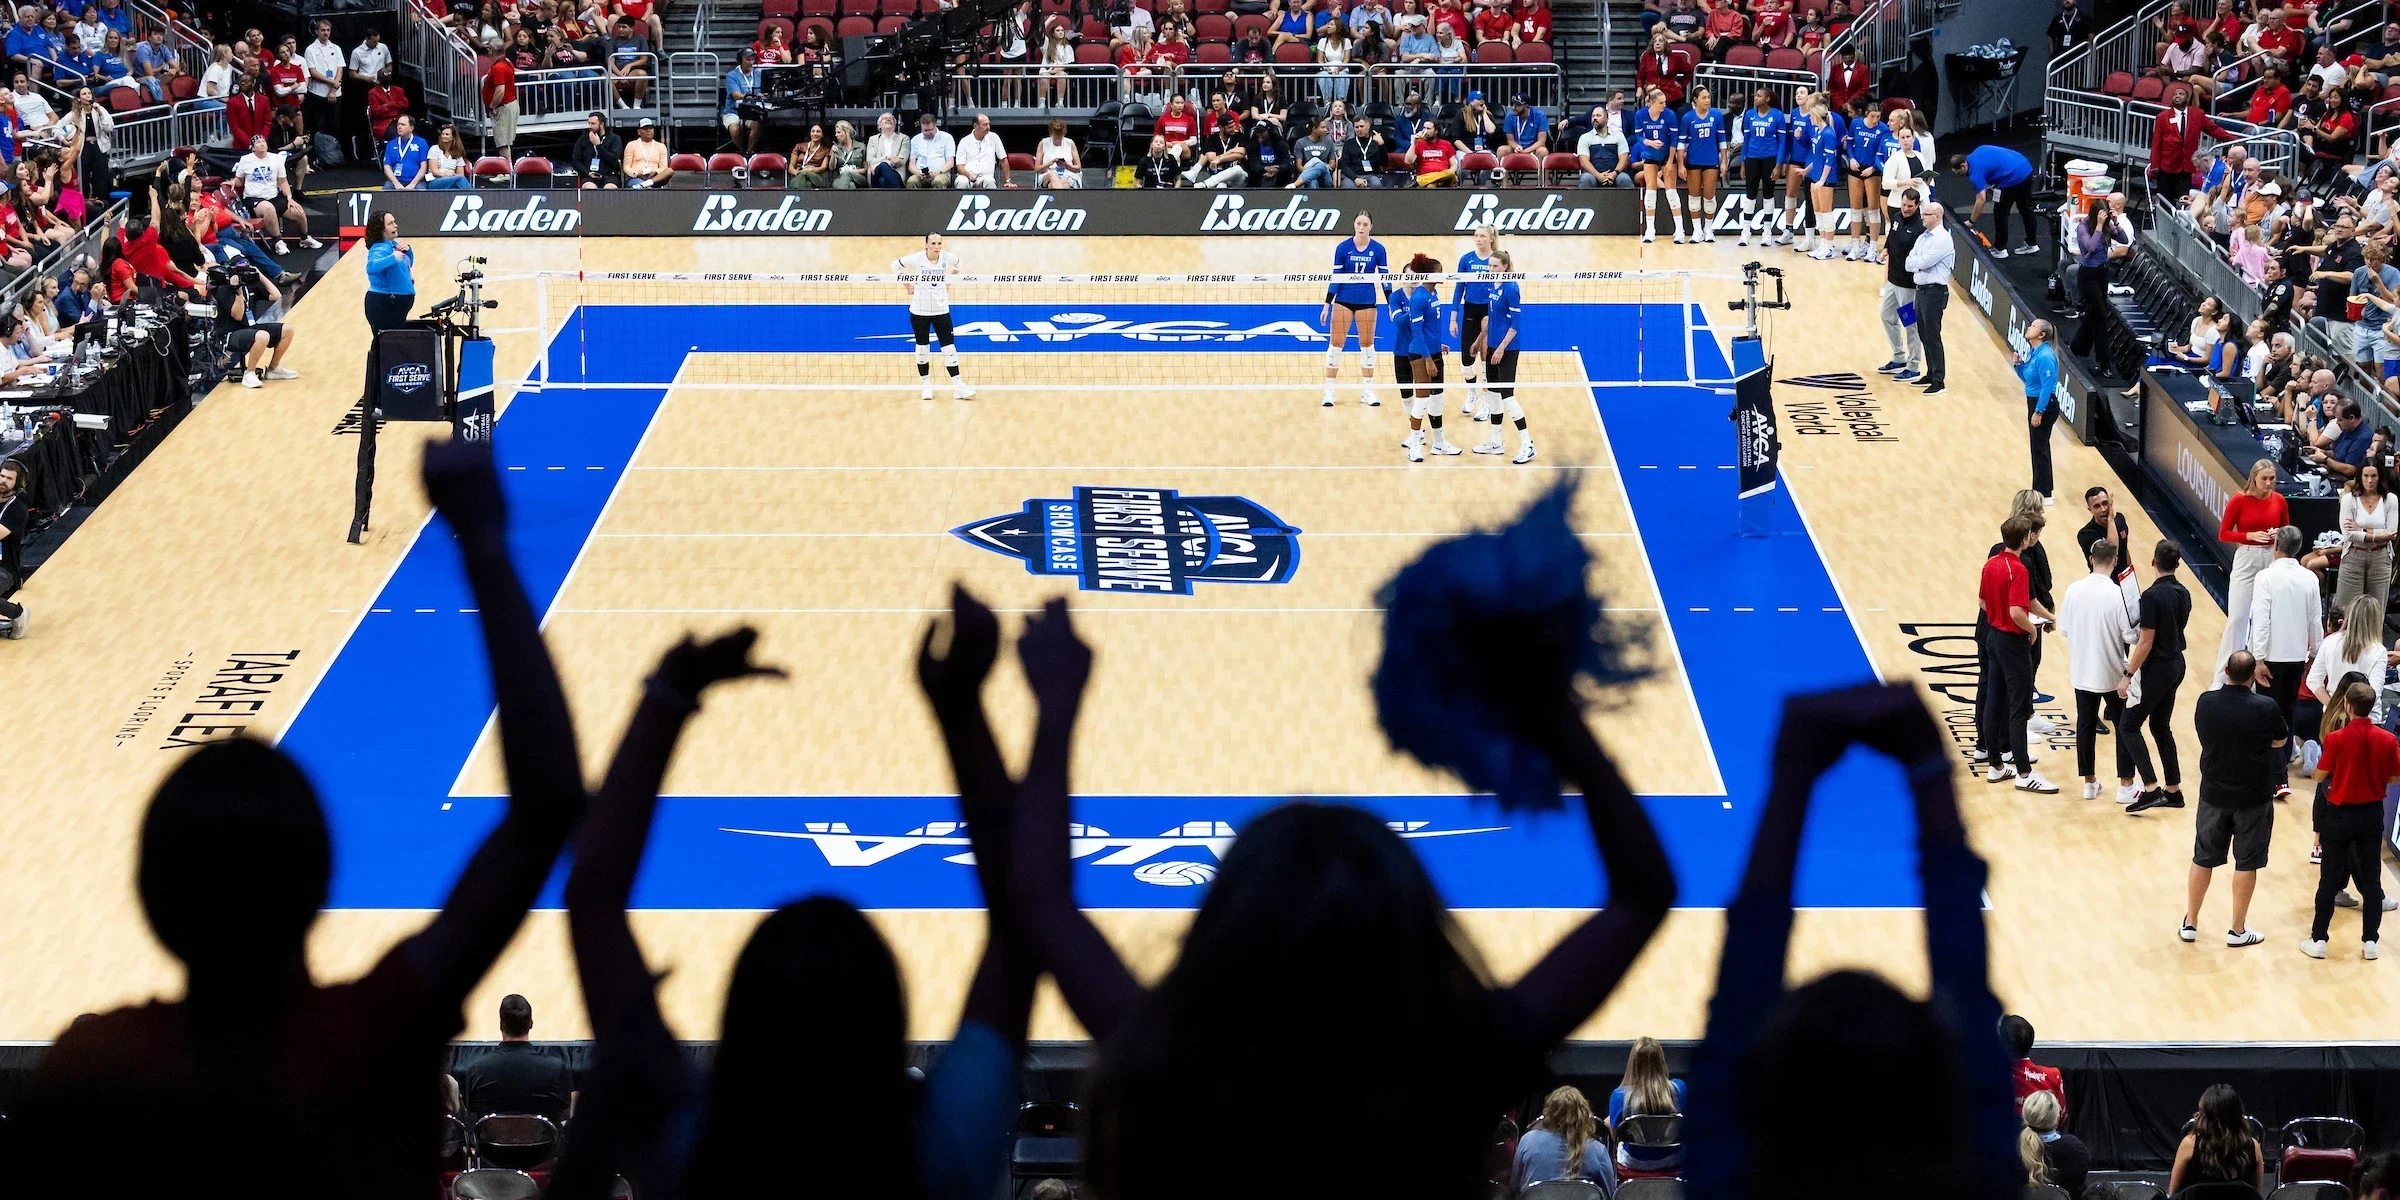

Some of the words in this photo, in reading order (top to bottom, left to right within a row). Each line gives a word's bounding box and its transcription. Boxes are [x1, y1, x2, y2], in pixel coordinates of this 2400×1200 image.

[1652, 129, 1659, 140] 8
[1699, 128, 1710, 138] 20
[1755, 127, 1766, 137] 10
[1858, 130, 1878, 139] KENTUCKY
[1863, 137, 1870, 148] 7
[349, 193, 373, 227] 17
[439, 195, 581, 232] Baden
[692, 194, 834, 232] Baden
[946, 194, 1088, 232] Baden
[1200, 194, 1341, 231] Baden
[1454, 193, 1595, 231] Baden
[1354, 262, 1366, 274] 17
[608, 272, 630, 280] FIRST
[632, 272, 657, 280] SERVE
[704, 273, 726, 281] FIRST
[728, 273, 753, 281] SERVE
[801, 274, 823, 282] FIRST
[825, 274, 850, 282] SERVE
[897, 274, 919, 282] FIRST
[921, 274, 946, 282] SERVE
[994, 274, 1016, 282] FIRST
[1018, 274, 1043, 282] SERVE
[1090, 274, 1112, 282] FIRST
[1114, 274, 1139, 282] SERVE
[1187, 274, 1209, 282] FIRST
[1211, 274, 1236, 282] SERVE
[1284, 273, 1306, 281] FIRST
[1308, 273, 1333, 281] SERVE
[1380, 273, 1402, 281] FIRST
[1404, 273, 1429, 281] SERVE
[1477, 273, 1499, 281] FIRST
[1501, 273, 1526, 281] SERVE
[1574, 271, 1596, 279] FIRST
[1598, 271, 1623, 279] SERVE
[1969, 257, 1993, 317] Baden
[397, 366, 421, 375] AVCA
[388, 374, 408, 383] FIRST
[409, 373, 431, 382] SERVE
[1784, 401, 1841, 435] World
[1833, 392, 1900, 442] Volleyball
[463, 408, 481, 442] CA
[1751, 405, 1771, 468] AVCA
[1091, 490, 1164, 535] FIRST
[1048, 504, 1078, 571] SHOWCASE
[1095, 537, 1173, 591] SERVE
